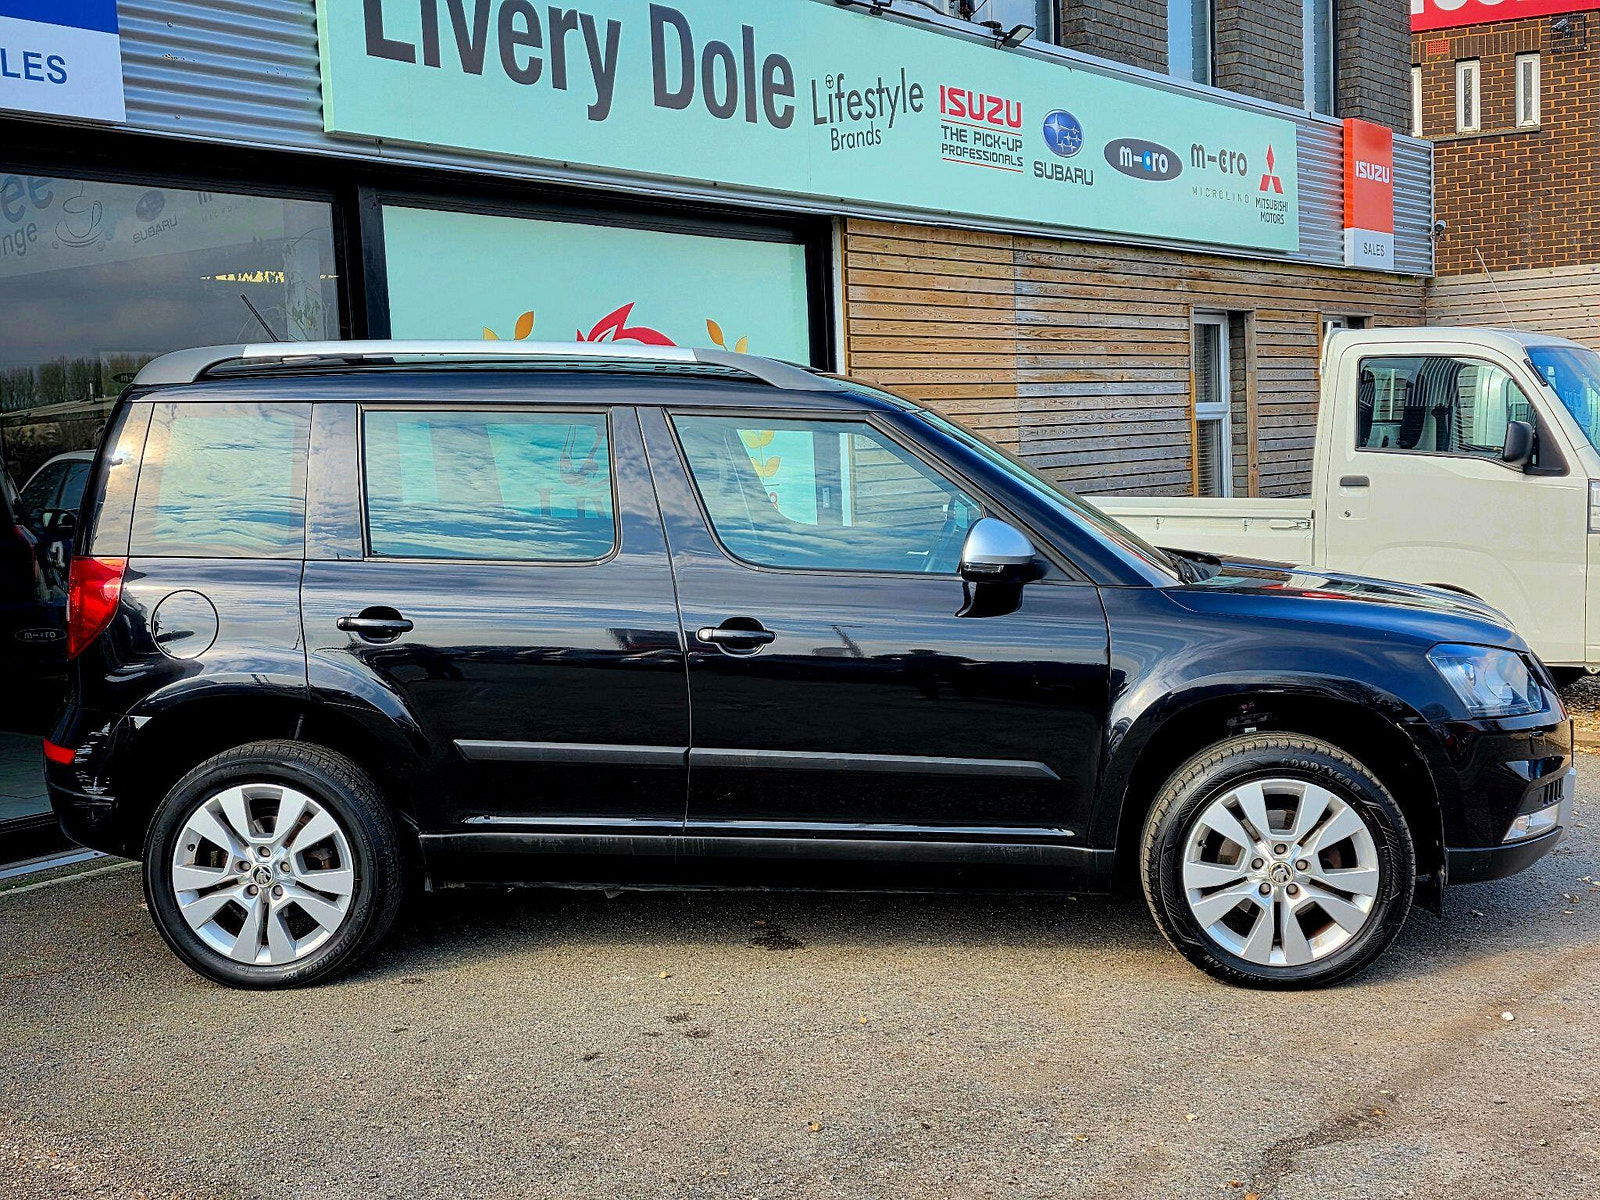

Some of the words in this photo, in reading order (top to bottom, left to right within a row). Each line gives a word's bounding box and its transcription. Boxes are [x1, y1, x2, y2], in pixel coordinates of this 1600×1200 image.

[363, 0, 622, 122] Livery
[649, 3, 796, 130] Dole
[811, 67, 924, 129] Lifestyle
[939, 84, 1022, 128] ISUZU
[830, 121, 882, 151] Brands
[940, 124, 969, 143] THE
[973, 131, 1023, 153] PICK-UP
[941, 143, 1024, 167] PROFESSIONALS
[1033, 160, 1094, 186] SUBARU
[1355, 160, 1390, 184] ISUZU
[1192, 186, 1250, 204] MICROLINO
[1255, 197, 1289, 213] MITSUBISHI
[132, 216, 178, 244] SUBARU
[1260, 211, 1285, 225] MOTORS
[1363, 242, 1385, 257] SALES
